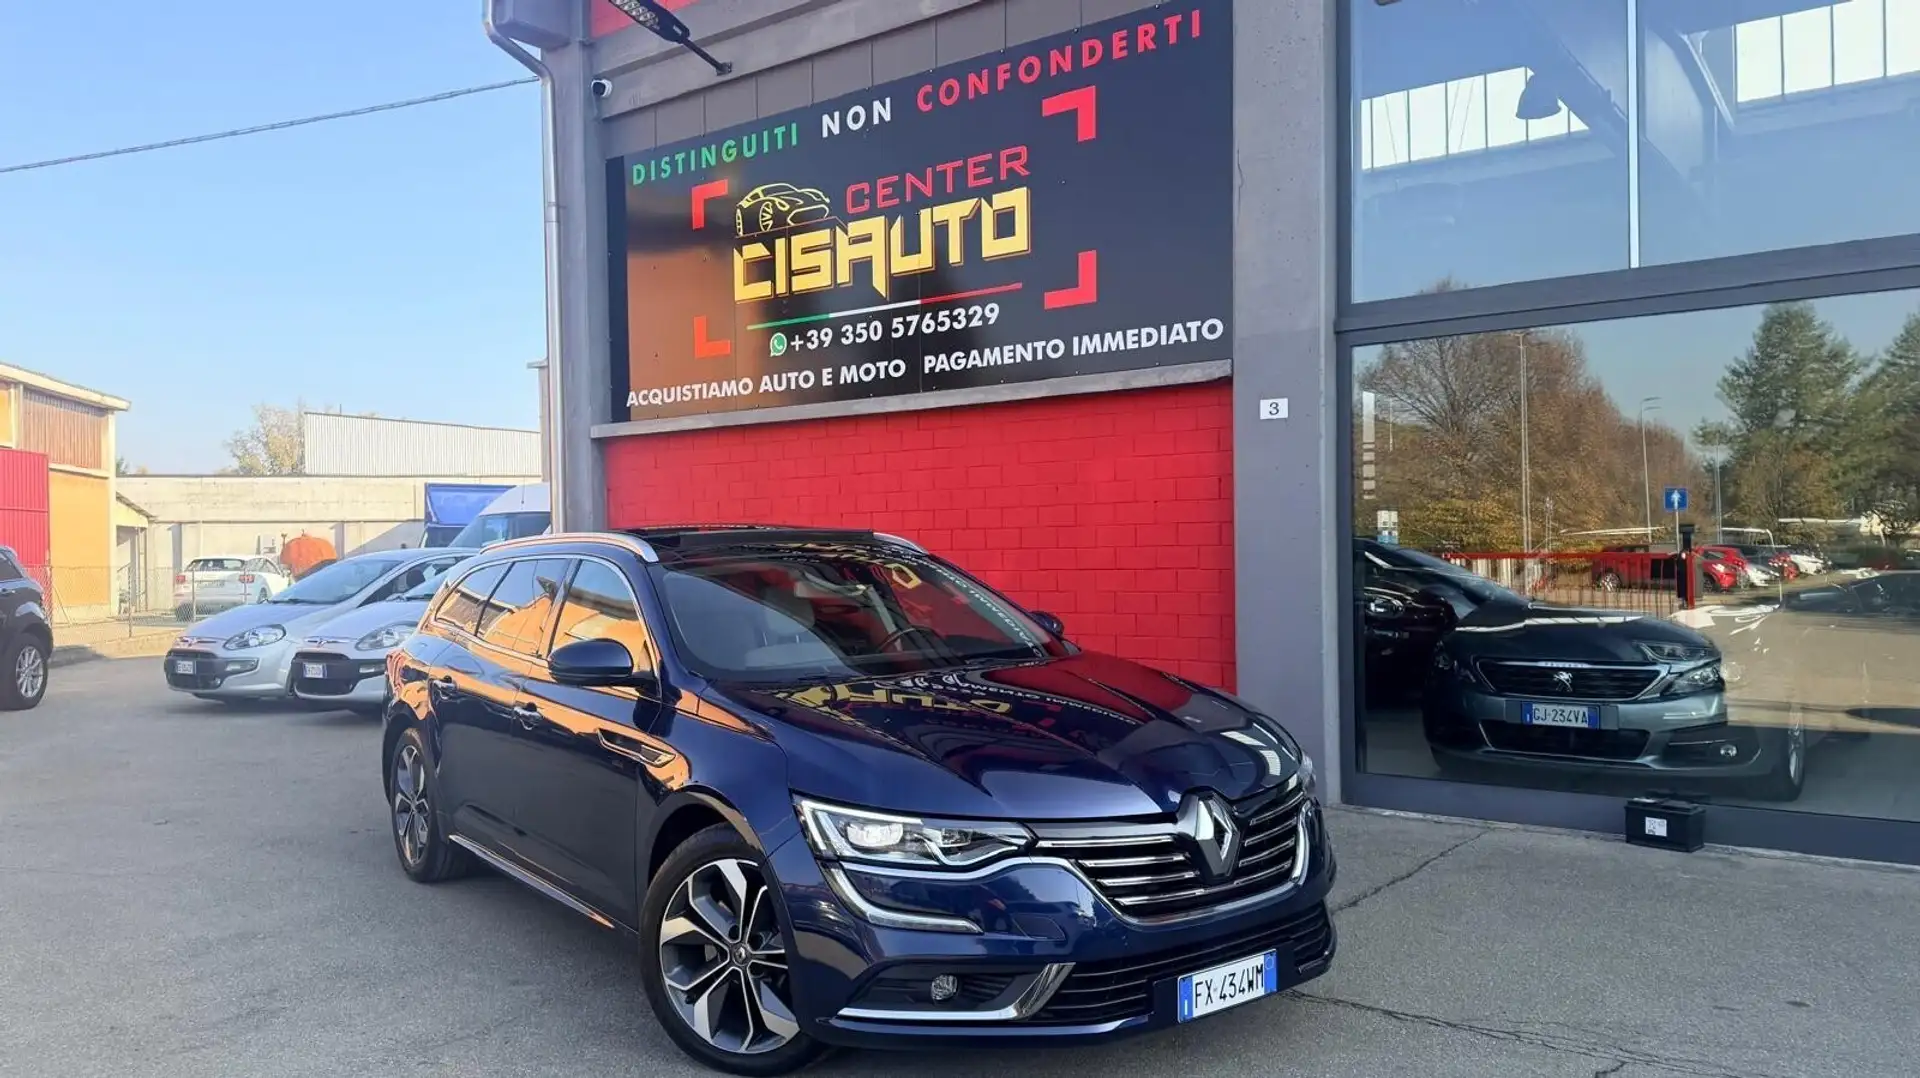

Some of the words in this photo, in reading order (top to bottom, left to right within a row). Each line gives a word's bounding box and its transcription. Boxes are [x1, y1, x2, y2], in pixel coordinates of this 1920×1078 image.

[632, 122, 798, 186] DISTINGUITI
[821, 97, 892, 138] NON
[916, 9, 1200, 112] CONFONDERTI
[846, 145, 1030, 214] CENTER
[733, 186, 1031, 304] CISAUTO
[626, 377, 754, 408] ACQUISTIAMO
[759, 370, 815, 394] AUTO
[821, 367, 833, 387] E
[839, 358, 906, 385] MOTO
[924, 338, 1066, 374] PAGAMENTO
[1072, 318, 1224, 357] IMMEDIATO
[790, 327, 833, 352] +39
[841, 319, 883, 345] 350
[891, 303, 1000, 339] 5765329
[1269, 401, 1280, 416] 3
